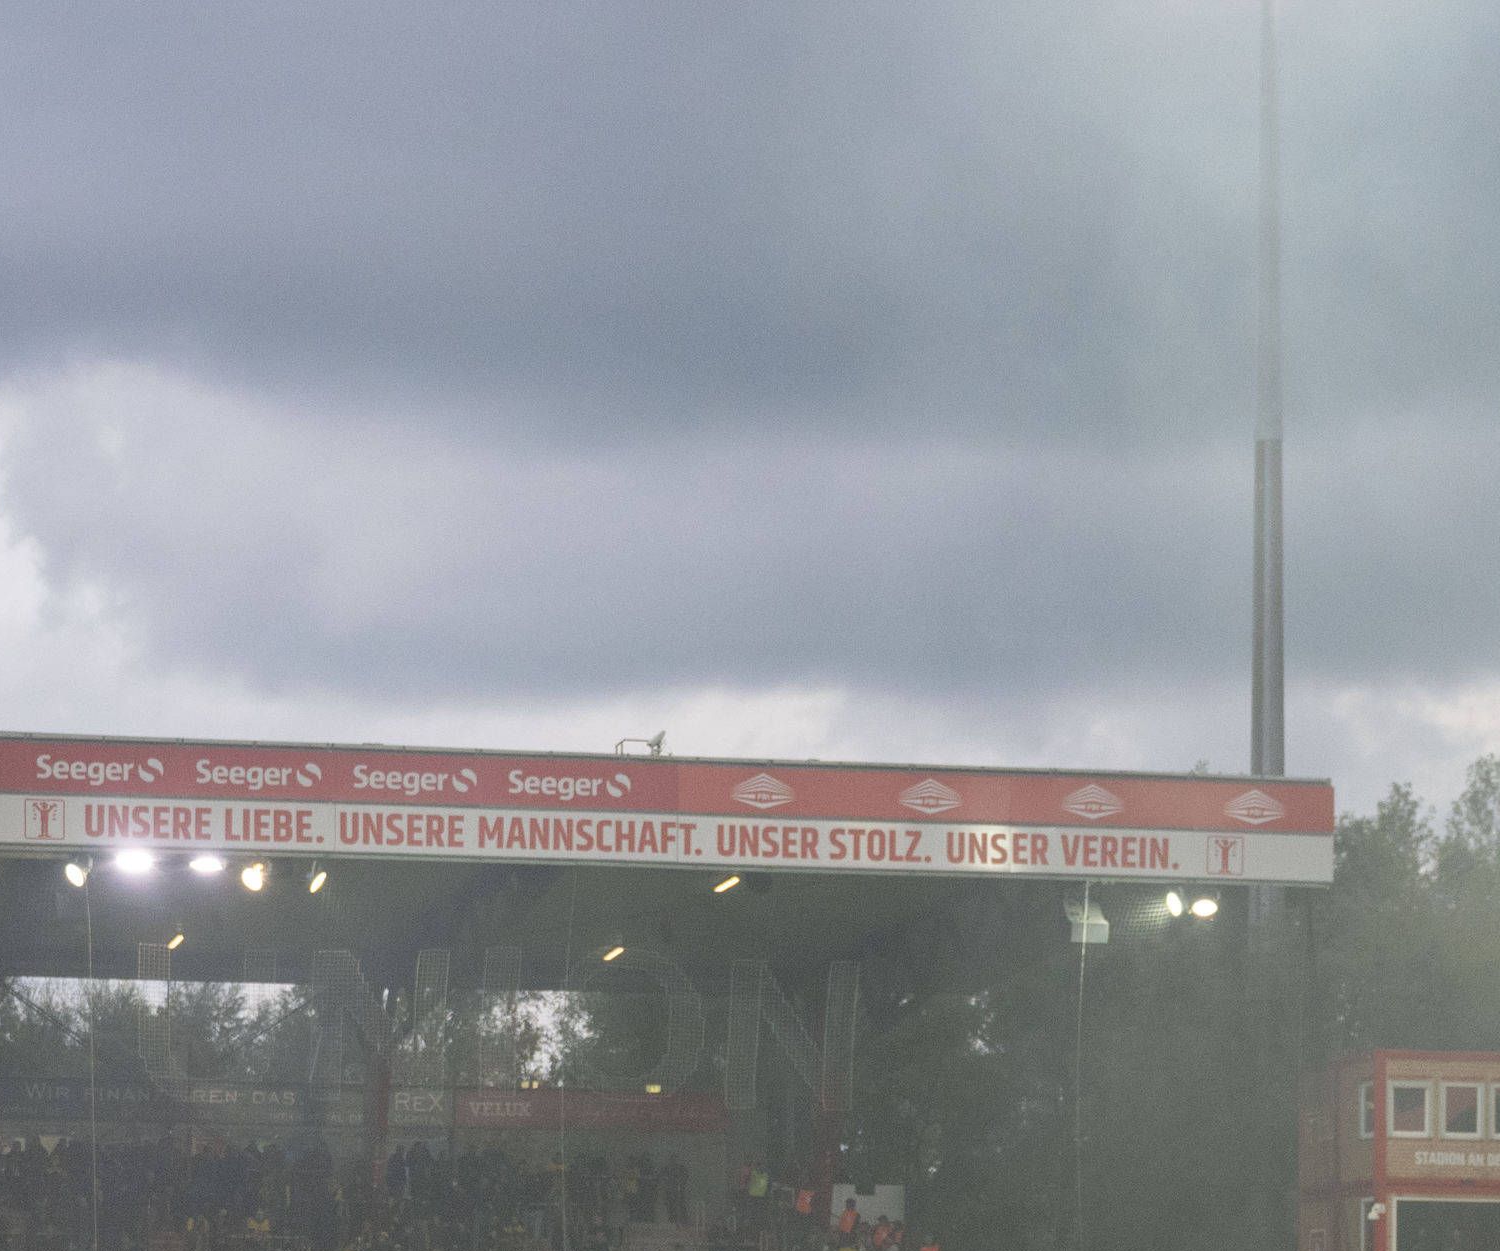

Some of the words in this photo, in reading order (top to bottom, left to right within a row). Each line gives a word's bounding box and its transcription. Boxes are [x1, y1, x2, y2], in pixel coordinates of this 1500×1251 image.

[36, 754, 134, 786] Seeger
[196, 759, 292, 791] Seeger
[353, 764, 448, 796] Seeger
[508, 769, 603, 801] Seeger
[85, 804, 211, 840] UNSERE
[224, 808, 325, 845] LIEBE.
[339, 811, 464, 849] UNSERE
[478, 816, 702, 856] MANNSCHAFT.
[717, 824, 819, 860] UNSER
[829, 827, 931, 864] STOLZ.
[946, 831, 1049, 867] UNSER
[1061, 835, 1180, 871] VEREIN.
[469, 1102, 531, 1117] VELUX
[1414, 1151, 1465, 1166] STADION
